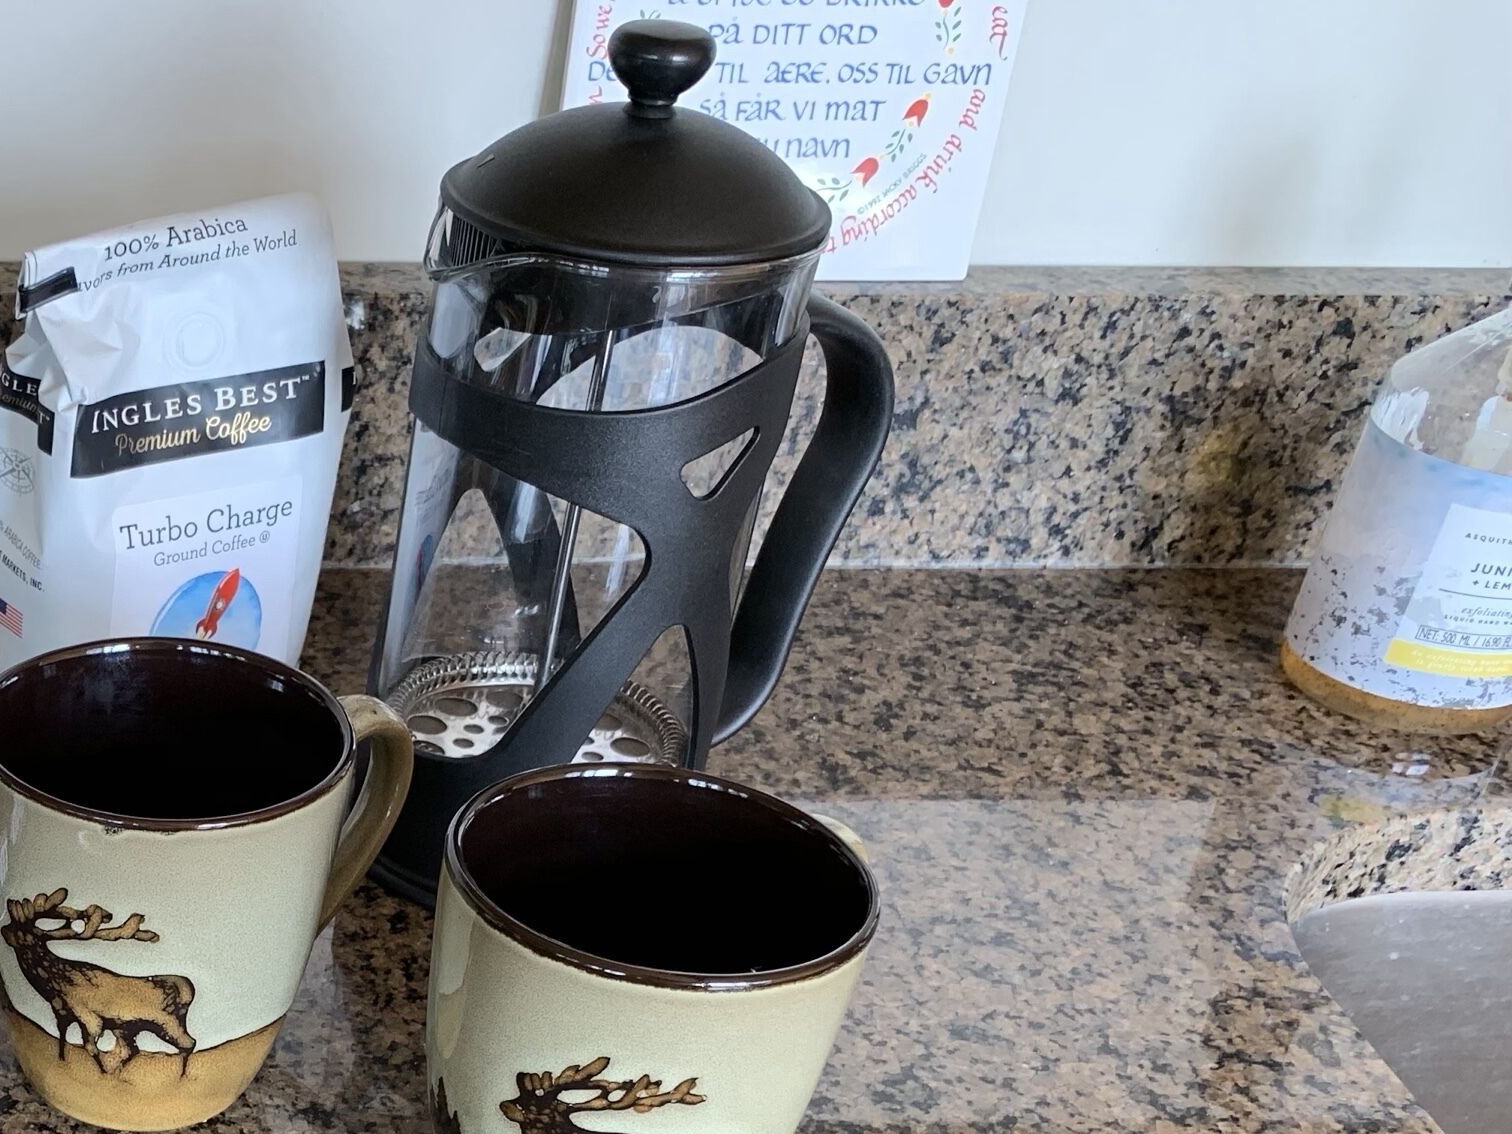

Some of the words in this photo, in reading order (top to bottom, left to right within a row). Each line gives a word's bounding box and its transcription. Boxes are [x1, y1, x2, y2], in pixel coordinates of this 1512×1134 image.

[752, 23, 811, 45] DITT
[819, 23, 878, 46] ORD
[715, 61, 750, 84] TIL
[838, 62, 879, 84] OSS
[885, 62, 916, 85] TIL
[958, 88, 987, 131] and
[915, 133, 962, 194] drink
[840, 184, 918, 247] according
[104, 233, 160, 262] 100%
[166, 218, 249, 248] Arabica
[116, 260, 155, 278] from
[157, 243, 221, 269] Around
[224, 240, 250, 259] the
[252, 229, 298, 254] World
[90, 395, 203, 434] INGLES
[114, 426, 201, 457] Premium
[205, 411, 272, 446] Coffee
[119, 514, 199, 551] Turbo
[205, 500, 294, 534] Charge
[153, 541, 209, 568] Ground
[211, 534, 257, 556] Coffee
